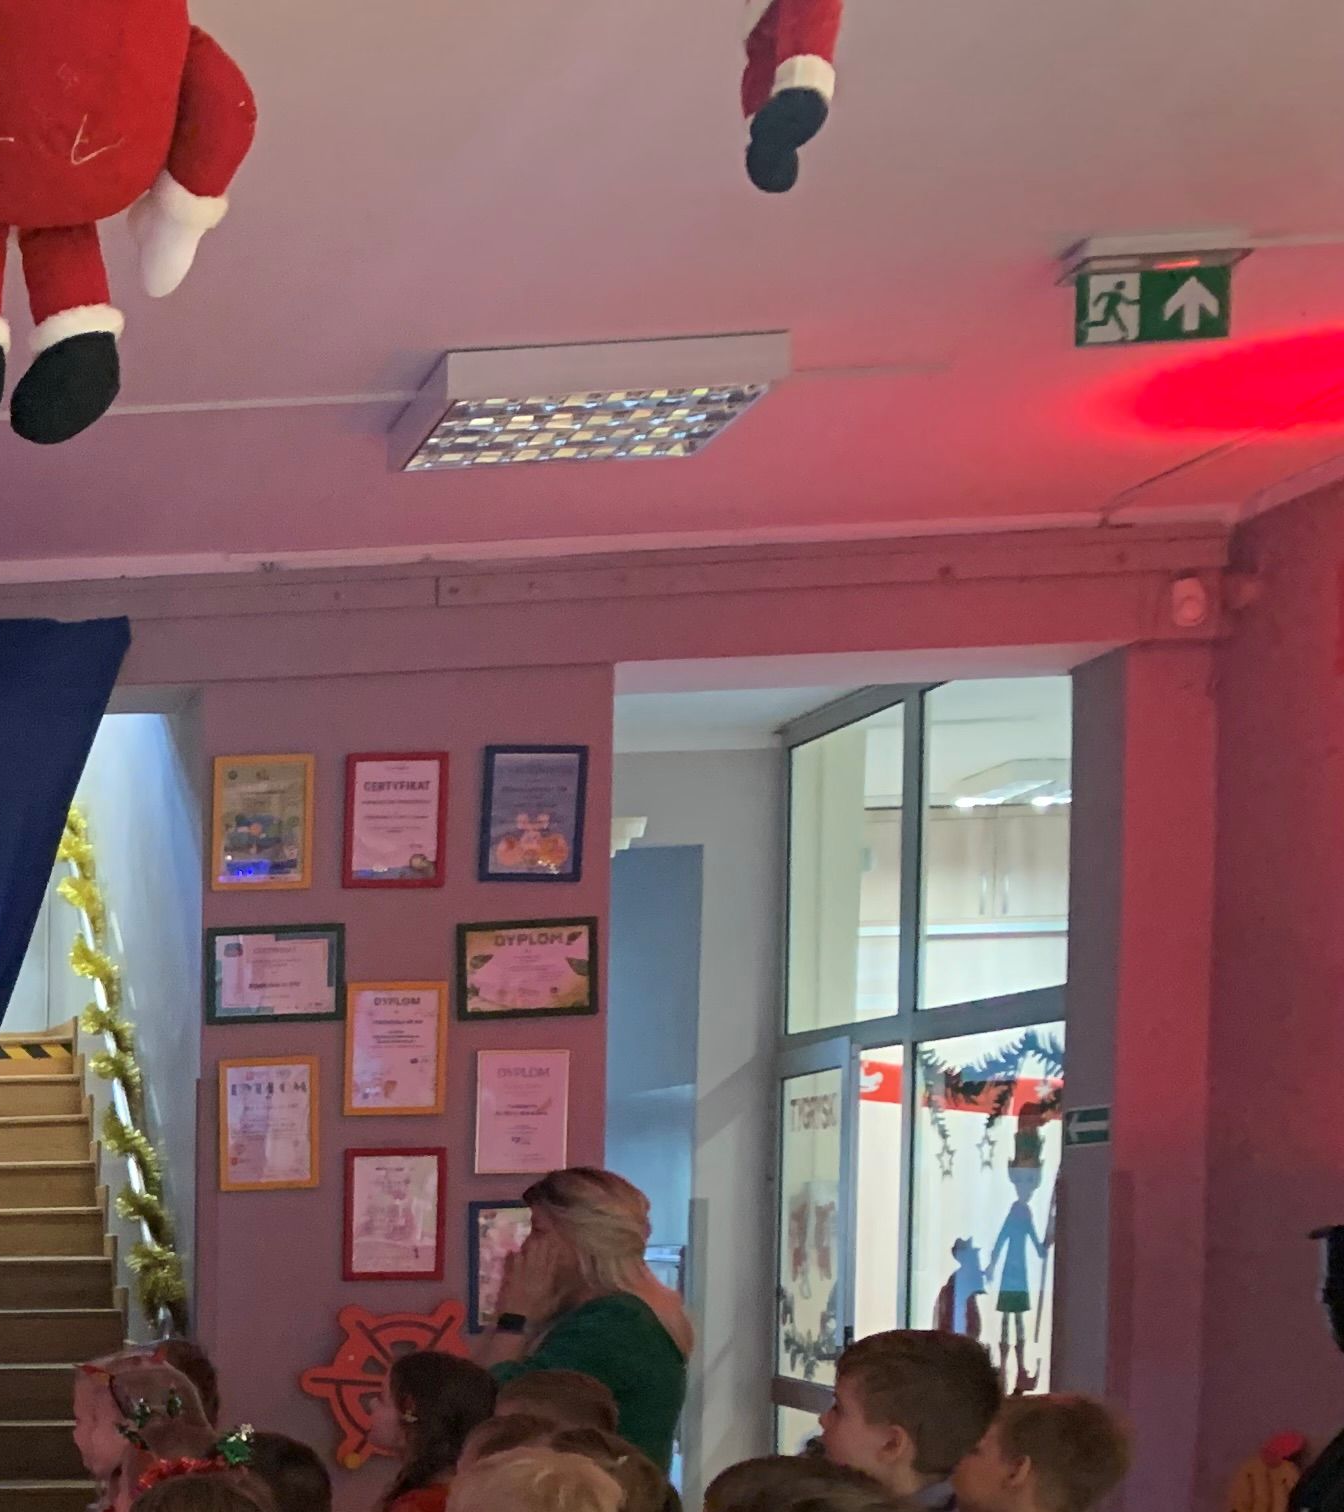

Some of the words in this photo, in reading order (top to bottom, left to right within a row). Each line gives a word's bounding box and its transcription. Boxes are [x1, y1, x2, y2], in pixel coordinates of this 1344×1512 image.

[363, 780, 431, 792] CERTYFIKAT
[493, 932, 565, 947] DYPLOM
[373, 996, 421, 1006] DYPLOM
[496, 1067, 551, 1079] DYPLOM
